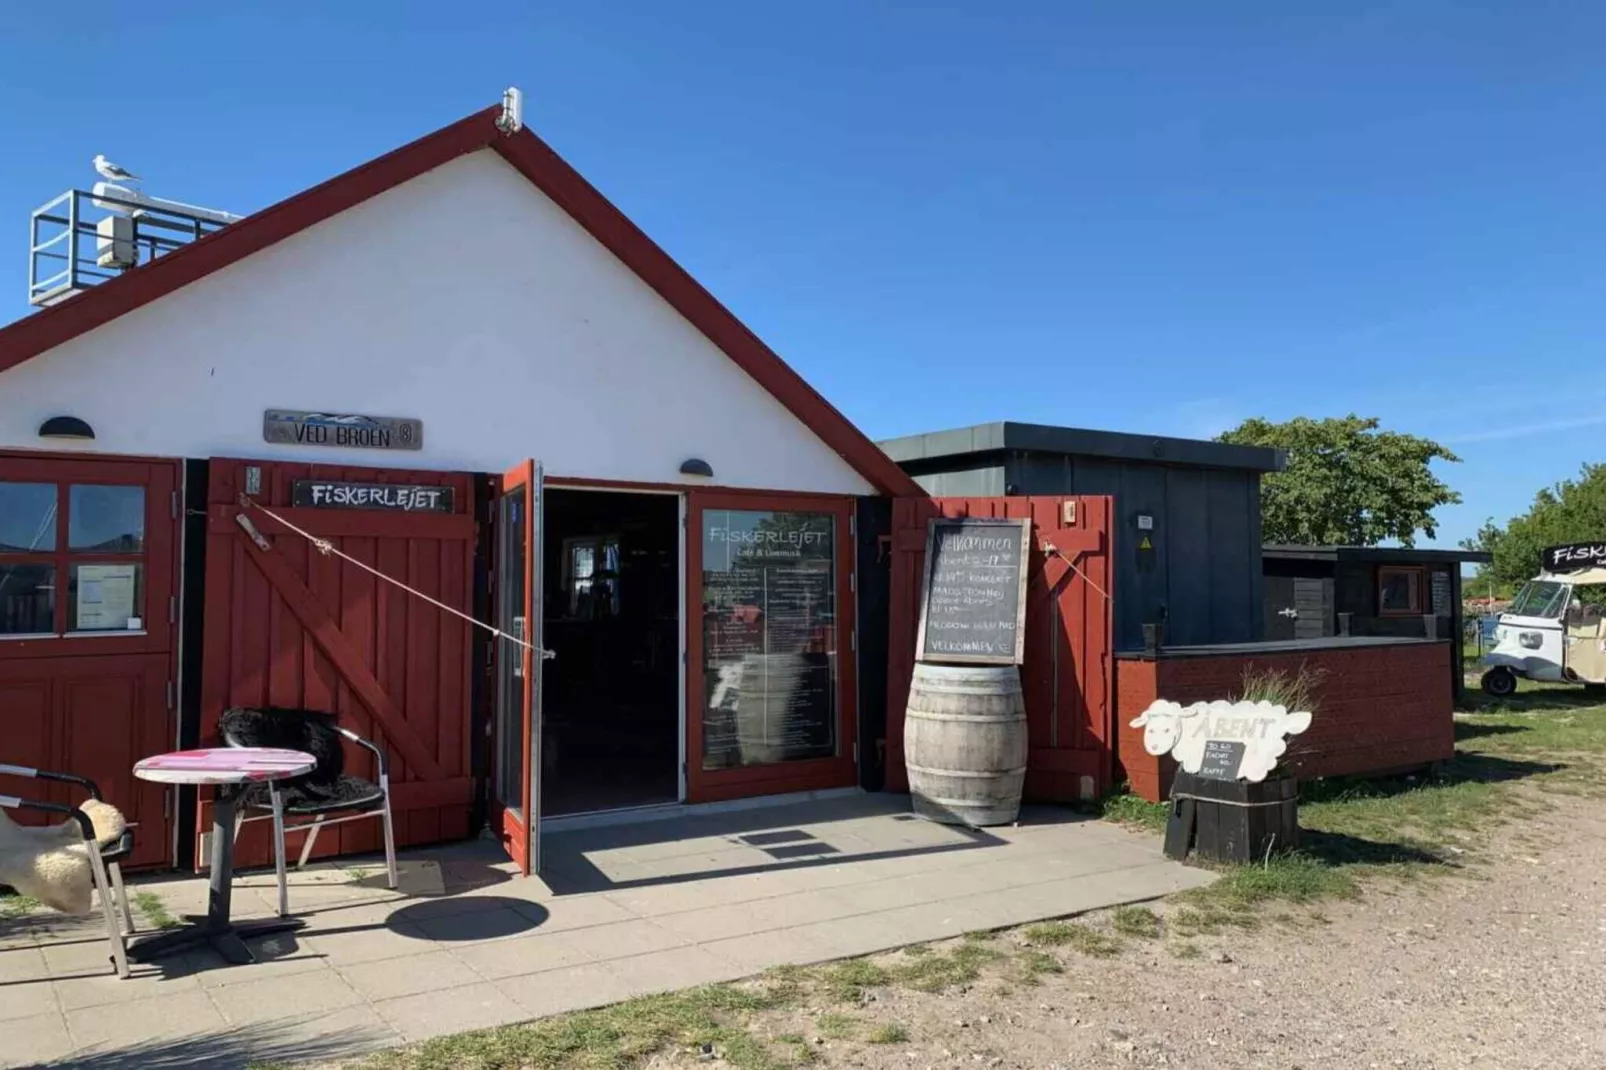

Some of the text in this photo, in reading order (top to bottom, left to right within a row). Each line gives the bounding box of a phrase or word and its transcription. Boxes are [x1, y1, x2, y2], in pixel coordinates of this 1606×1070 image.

[294, 422, 327, 444] VED
[335, 426, 391, 448] BROEN
[1552, 545, 1606, 565] FiSK
